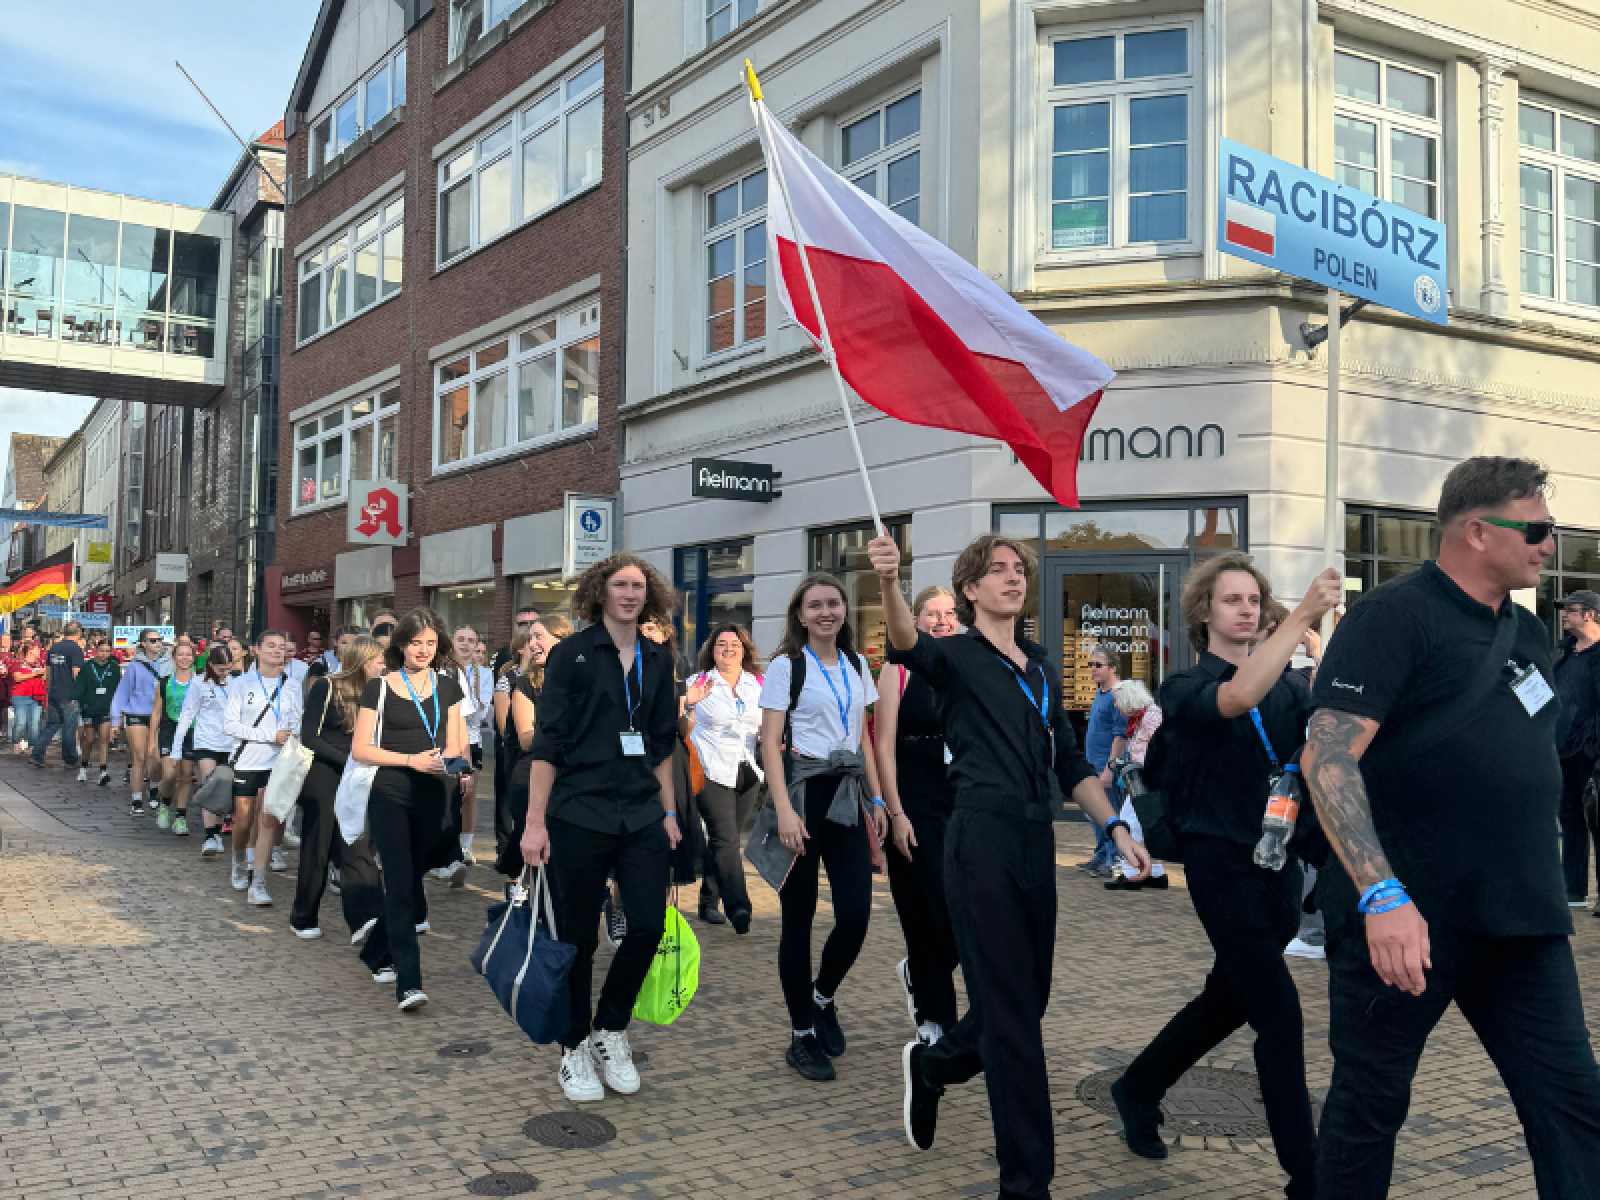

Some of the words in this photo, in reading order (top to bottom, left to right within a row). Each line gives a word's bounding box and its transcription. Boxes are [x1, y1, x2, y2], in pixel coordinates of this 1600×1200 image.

[1227, 153, 1441, 271] RACIBÓRZ
[1313, 247, 1379, 291] POLEN
[247, 691, 255, 705] 2
